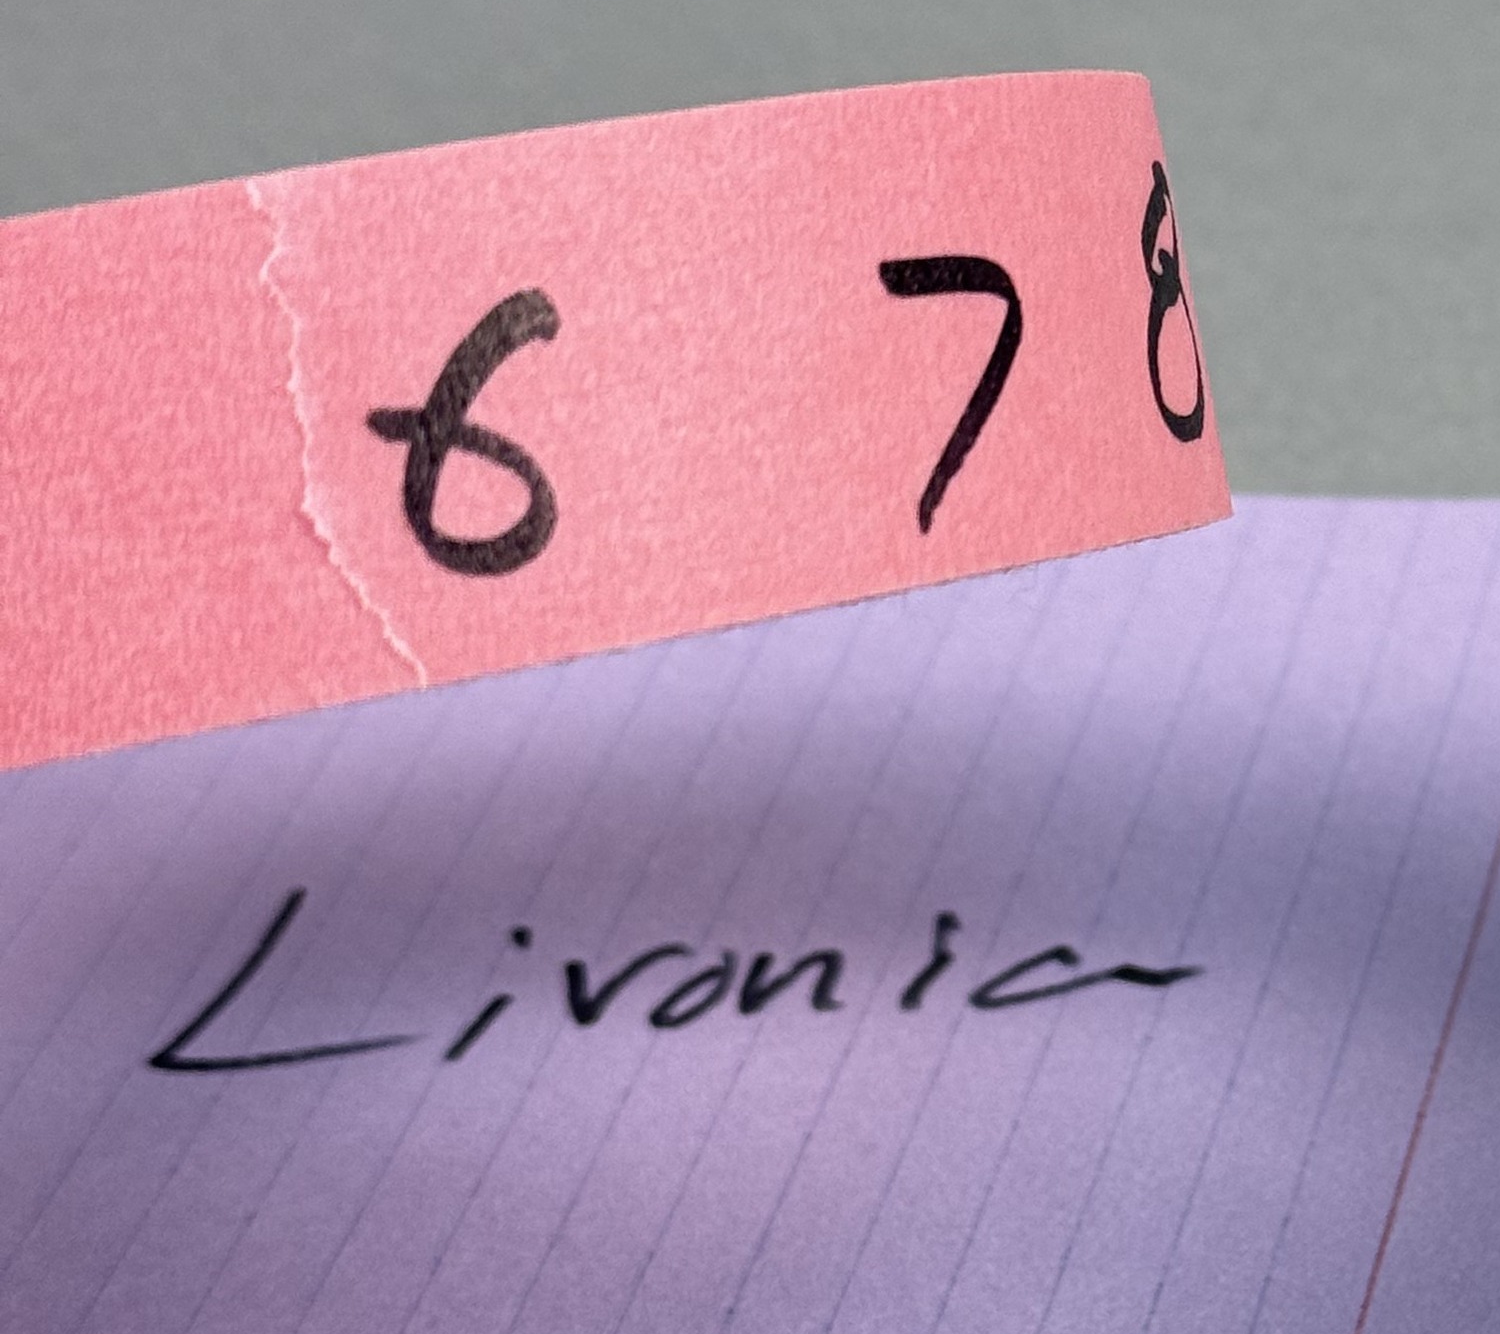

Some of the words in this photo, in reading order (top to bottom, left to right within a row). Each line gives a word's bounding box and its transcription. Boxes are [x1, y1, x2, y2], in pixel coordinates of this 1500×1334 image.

[876, 253, 1024, 535] 7
[1140, 160, 1206, 444] 8
[144, 887, 1206, 1075] Livonia
